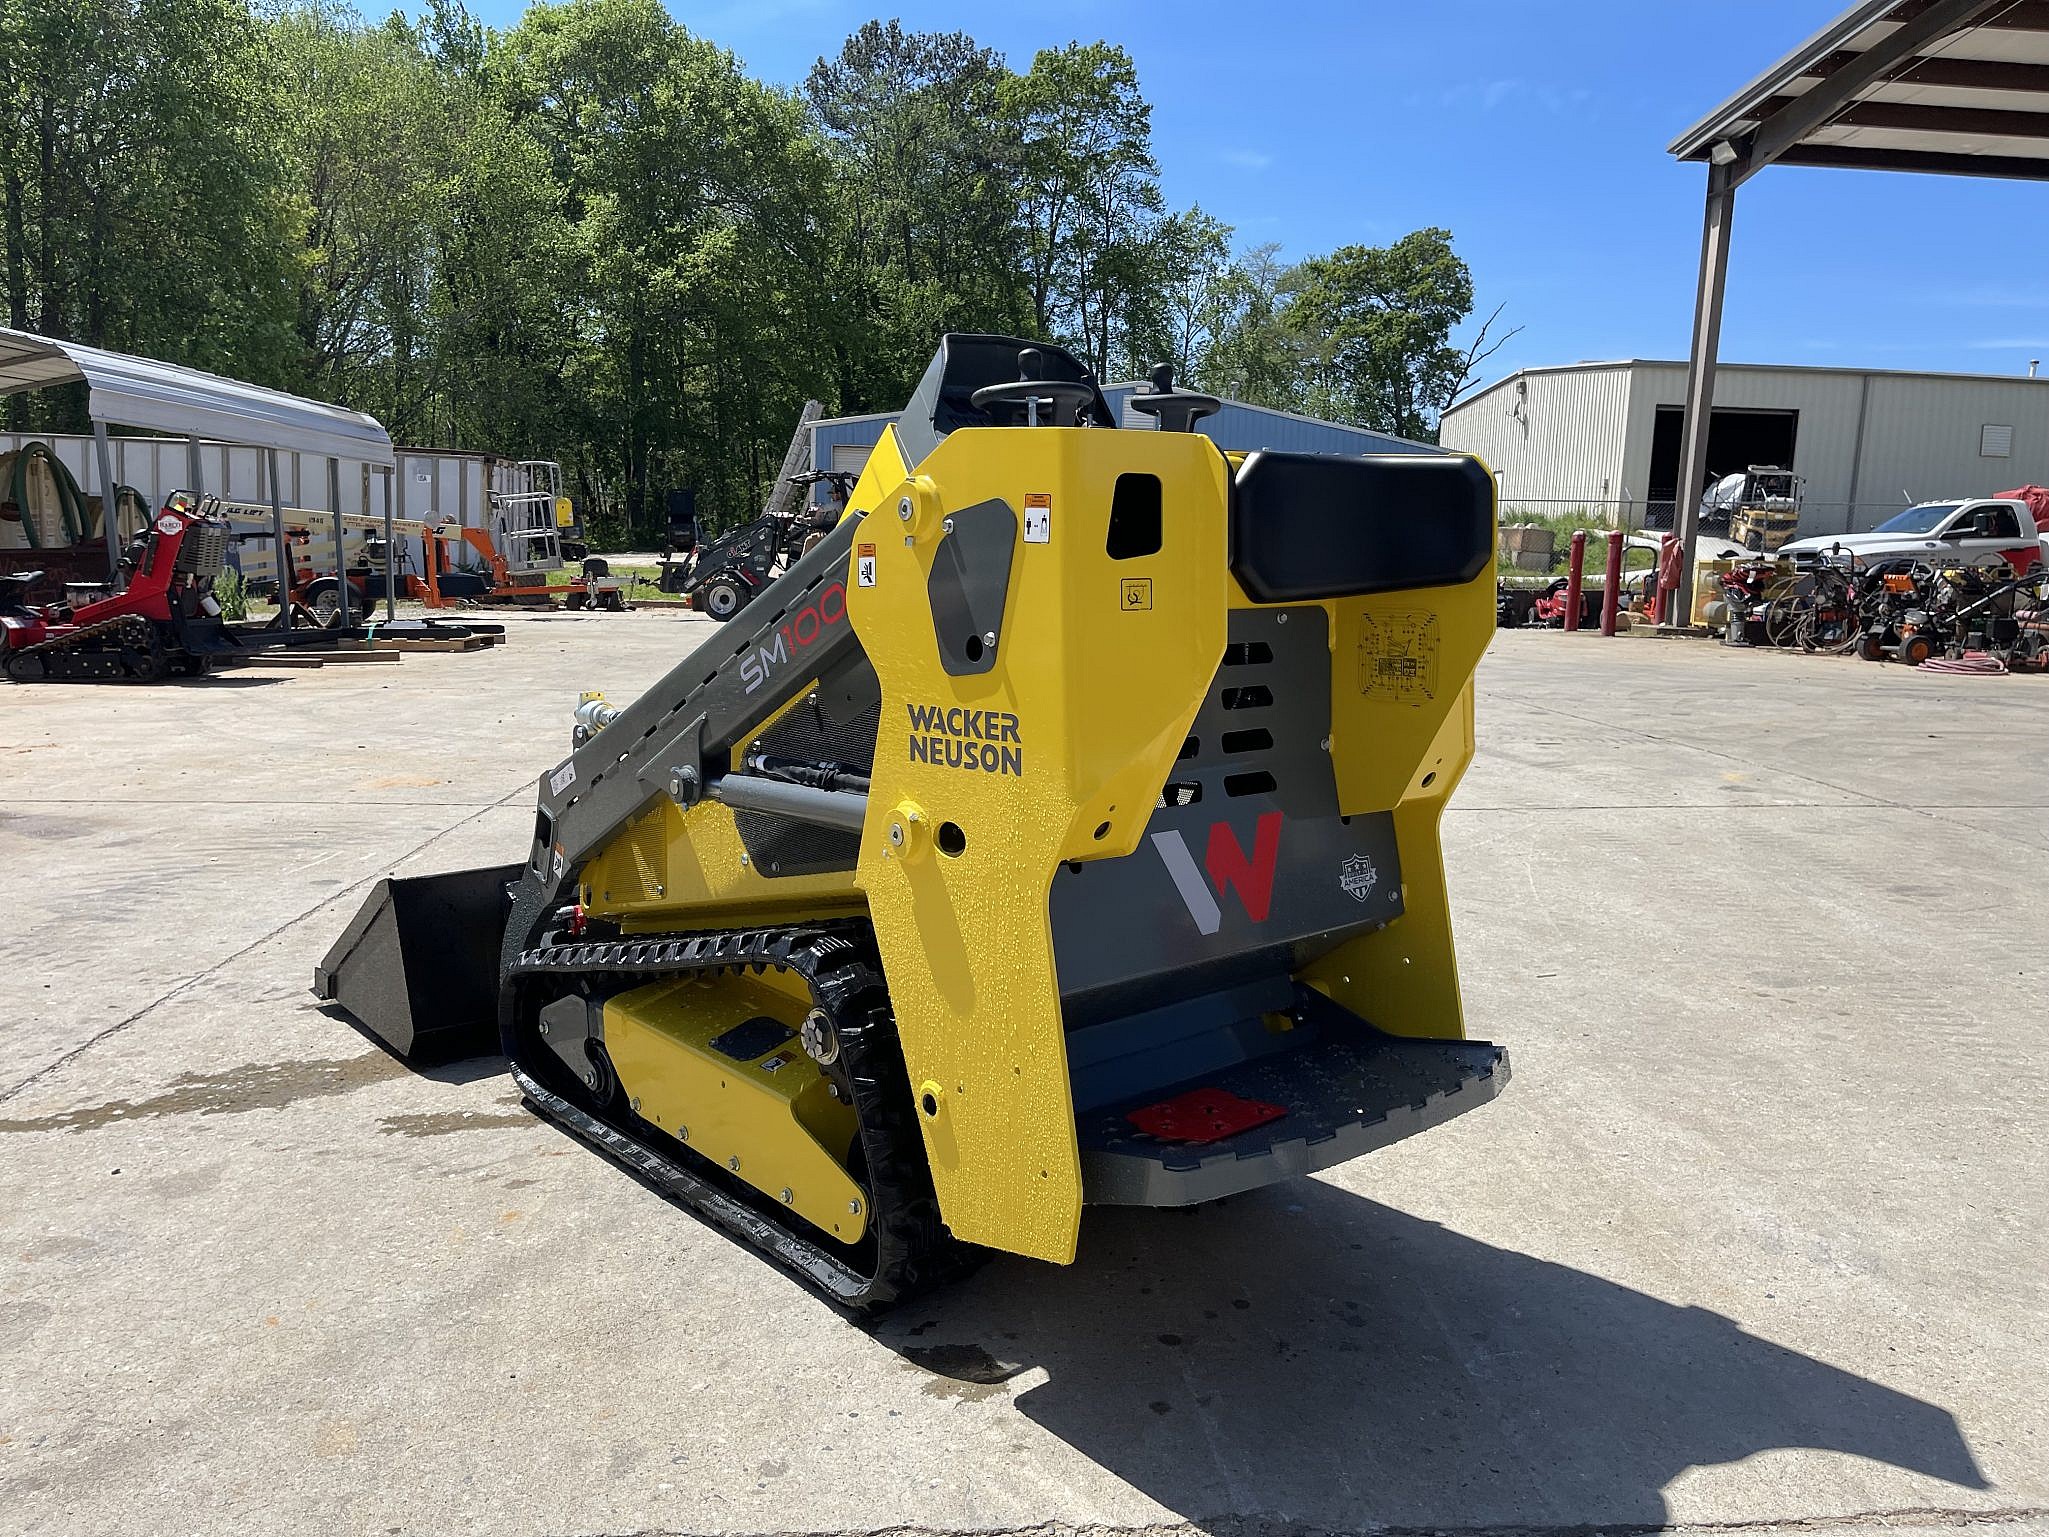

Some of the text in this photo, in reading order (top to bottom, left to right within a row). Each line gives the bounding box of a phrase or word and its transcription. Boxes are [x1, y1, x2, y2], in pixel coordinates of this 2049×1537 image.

[740, 582, 847, 695] SM100
[906, 703, 1022, 744] WACKER
[909, 735, 1022, 777] NEUSON
[1343, 872, 1375, 887] AMERICA
